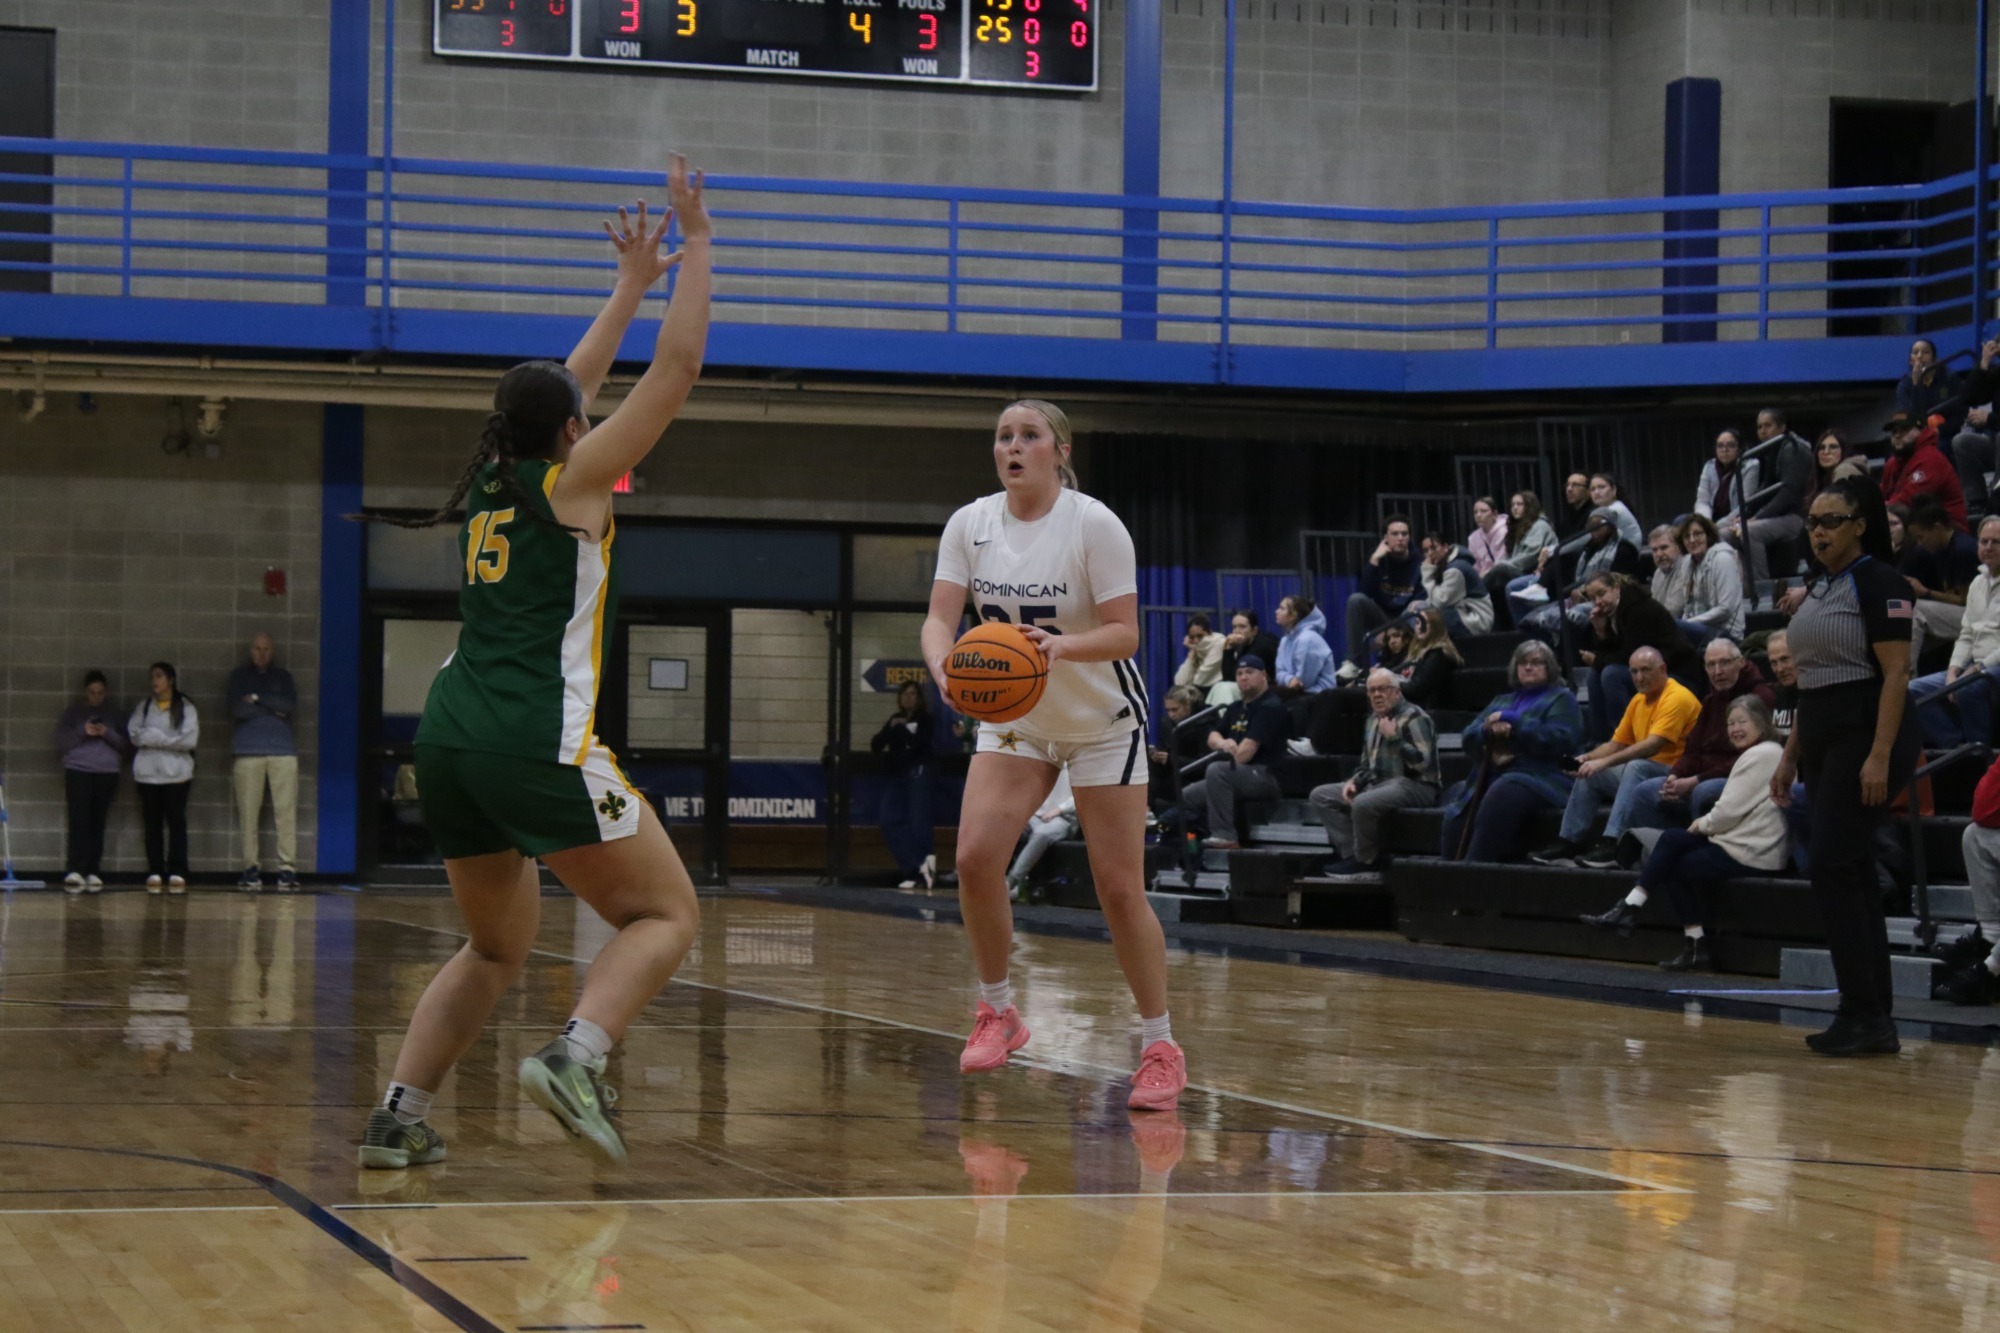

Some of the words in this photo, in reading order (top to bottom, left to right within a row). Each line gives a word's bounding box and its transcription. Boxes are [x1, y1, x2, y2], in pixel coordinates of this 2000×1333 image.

[620, 0, 640, 32] 3
[676, 0, 696, 36] 3
[849, 12, 871, 44] 4
[500, 20, 515, 47] 3
[918, 13, 938, 50] 3
[976, 15, 1012, 43] 25
[1024, 18, 1040, 44] 0
[1071, 21, 1087, 48] 0
[605, 40, 641, 58] WON
[746, 49, 800, 67] MATCH
[902, 57, 939, 75] WON
[1025, 50, 1040, 78] 3
[466, 507, 515, 585] 15
[973, 578, 1067, 598] DOMINICAN
[951, 650, 1011, 673] Wilson
[727, 798, 815, 818] OMINICAN
